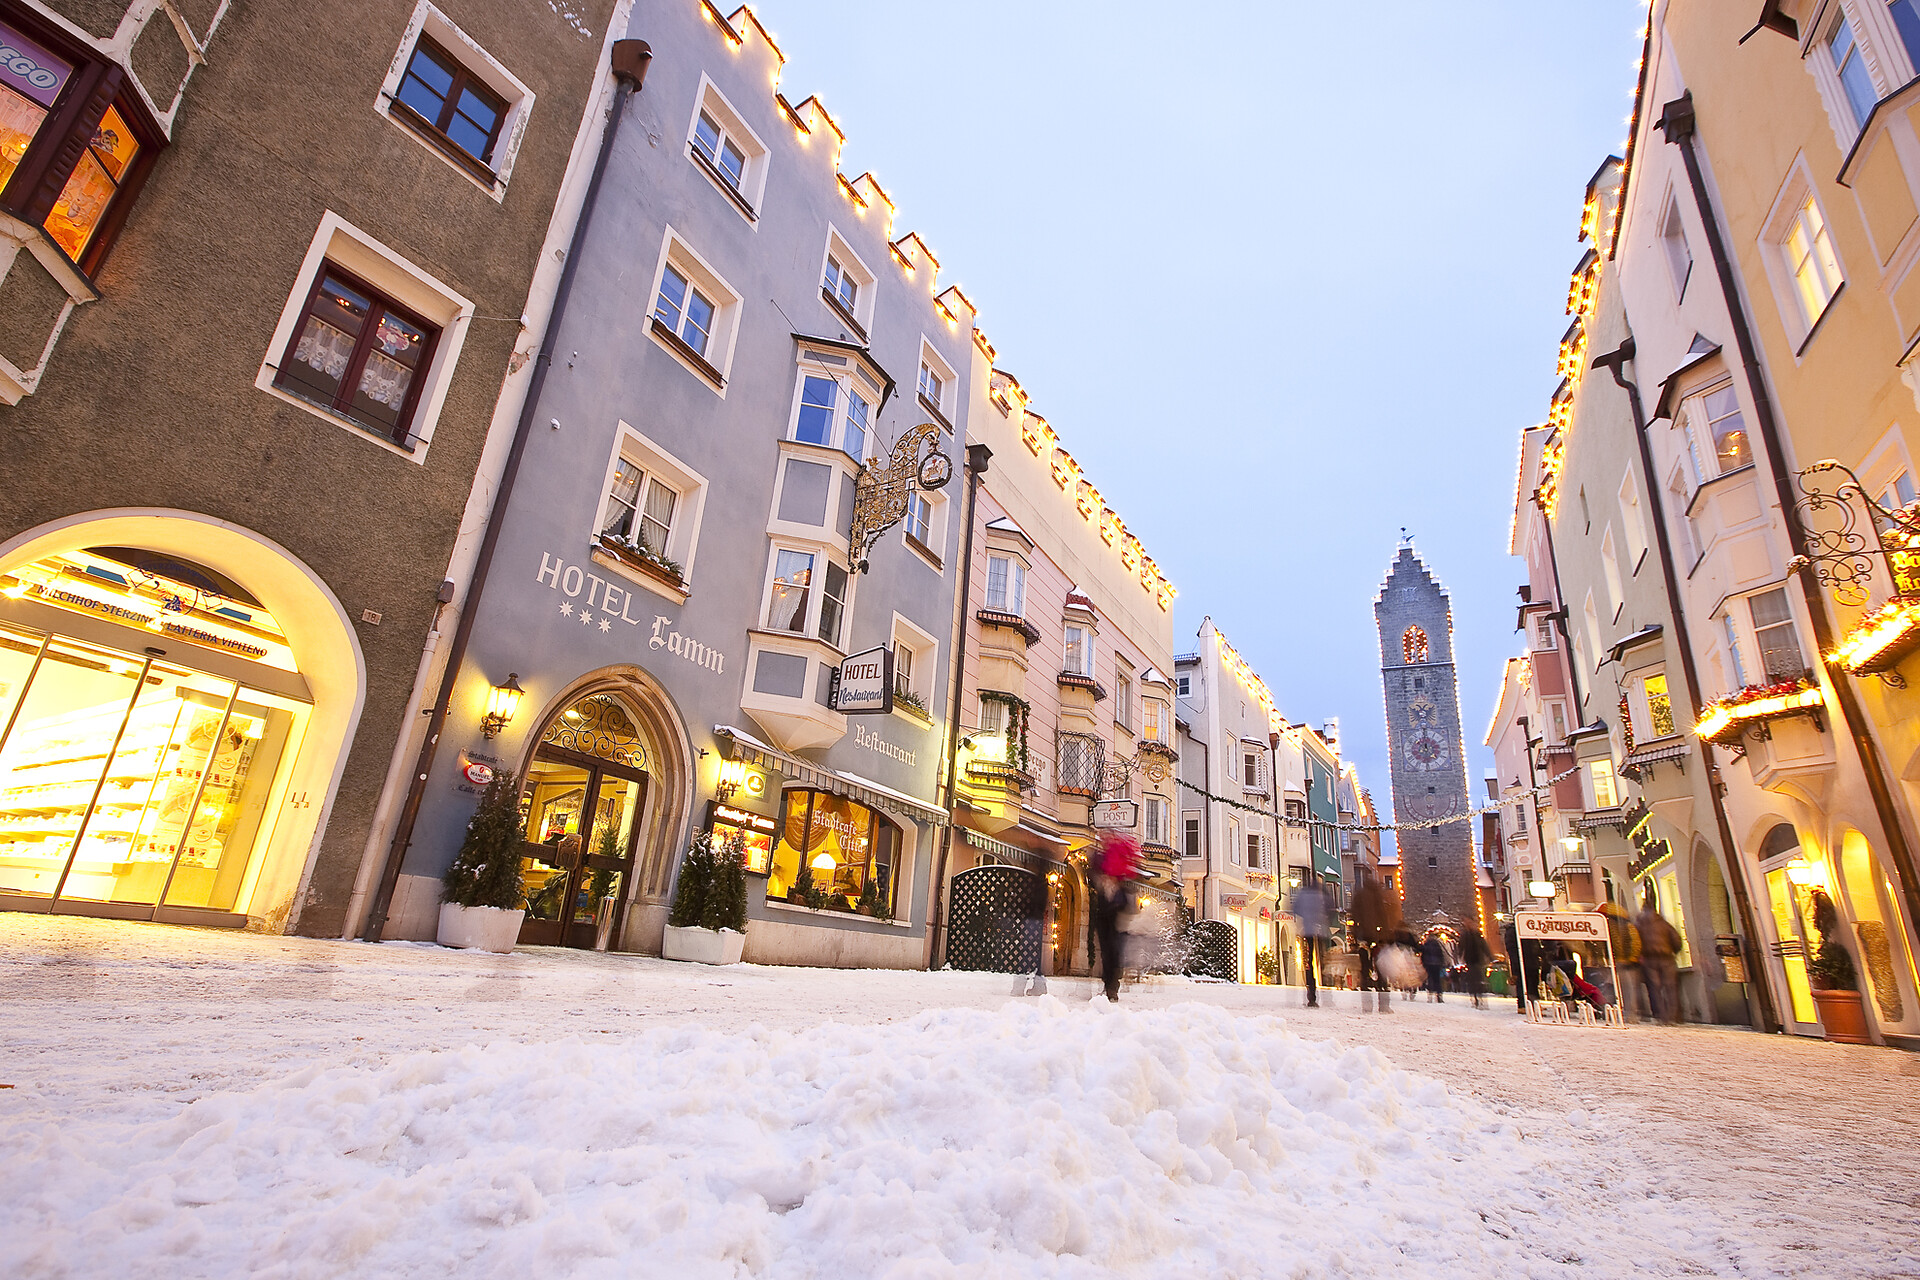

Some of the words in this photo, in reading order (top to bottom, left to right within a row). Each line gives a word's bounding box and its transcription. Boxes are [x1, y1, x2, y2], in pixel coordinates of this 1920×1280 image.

[0, 40, 58, 89] EGO
[535, 550, 641, 626] HOTEL
[648, 614, 725, 675] Lamm
[166, 622, 218, 644] LATTERIA
[221, 636, 268, 657] VIPITENO
[844, 663, 882, 681] HOTEL
[839, 687, 884, 705] Restaurant
[854, 723, 917, 767] Restaurant
[470, 771, 491, 780] MANUEL
[1103, 811, 1128, 822] POST
